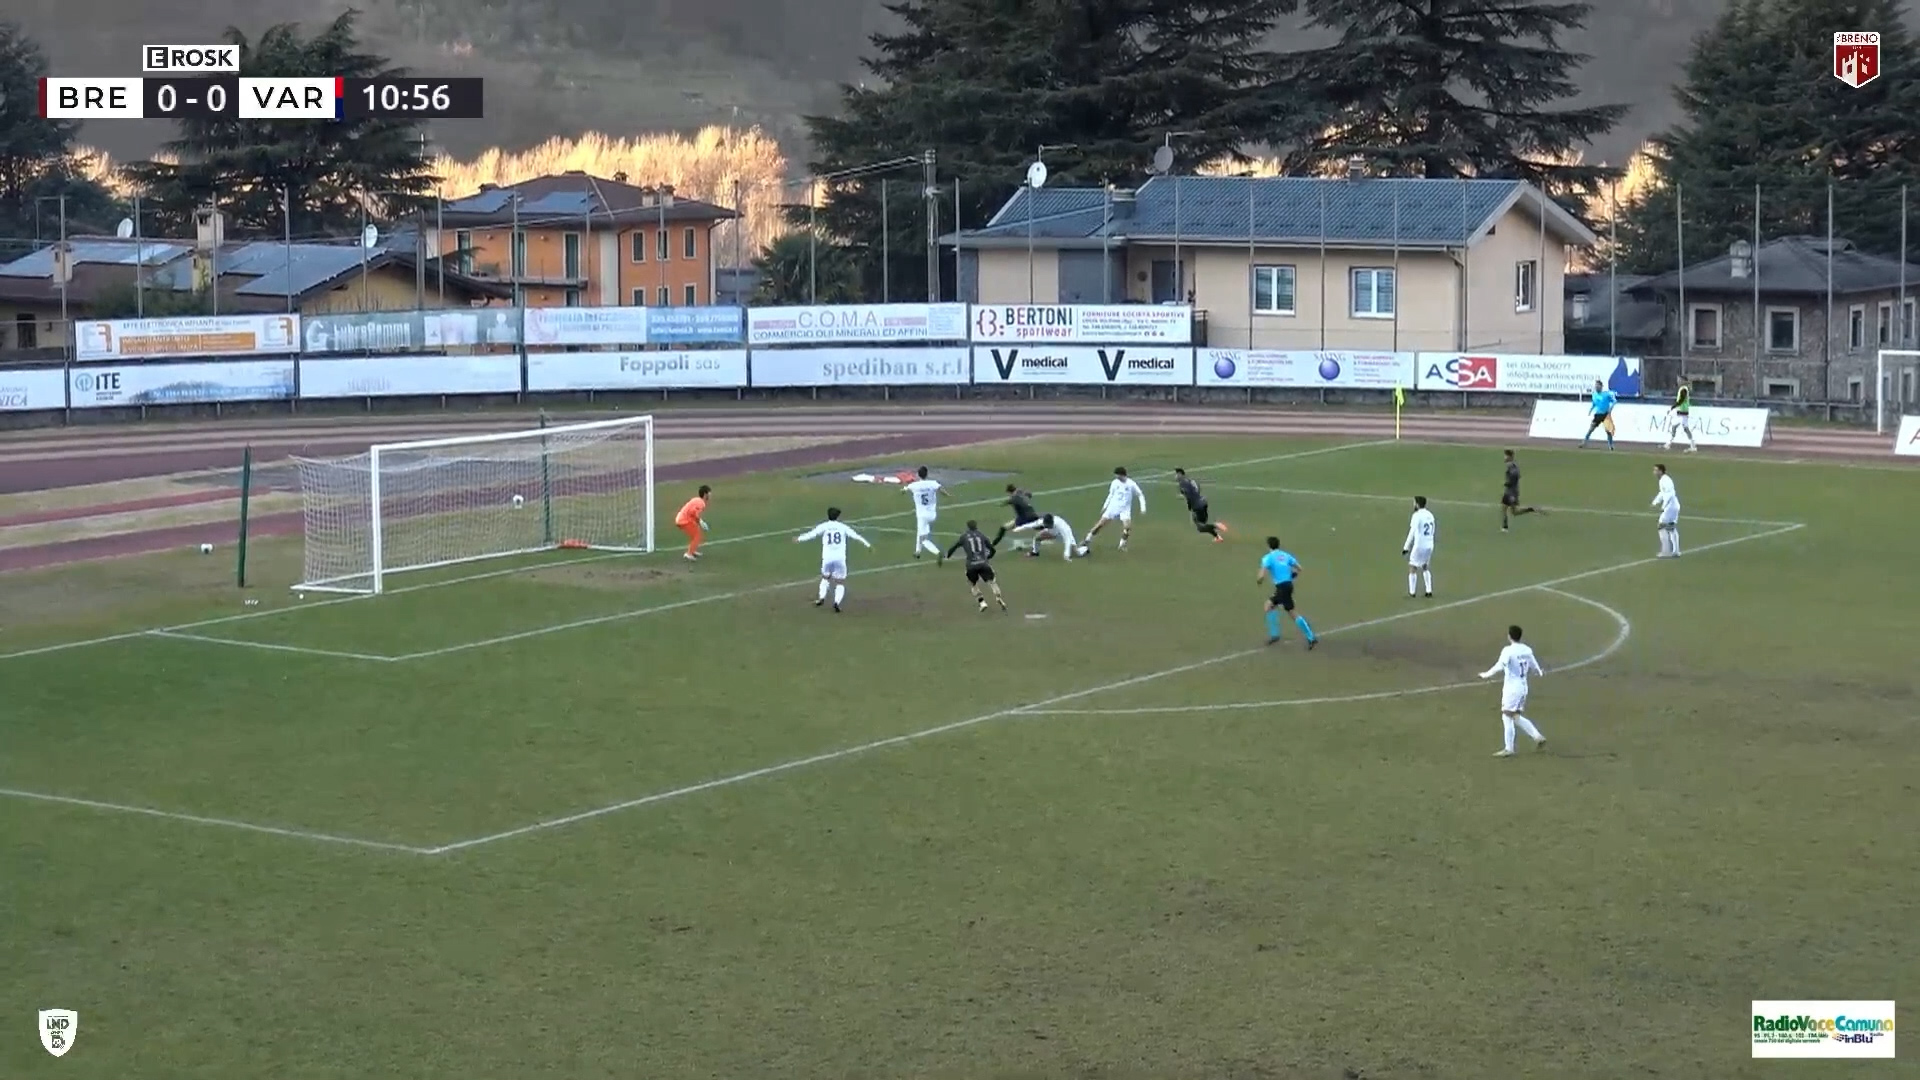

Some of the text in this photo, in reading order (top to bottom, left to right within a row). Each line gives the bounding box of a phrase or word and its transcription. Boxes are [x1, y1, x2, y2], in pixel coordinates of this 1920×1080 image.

[1006, 308, 1073, 326] BERTONI
[753, 329, 814, 340] COMMERCIO
[835, 328, 880, 338] MINERALI
[897, 328, 928, 337] AFFINI
[1016, 327, 1073, 338] sportwear
[620, 355, 720, 375] Foppoli sas
[823, 357, 918, 380] spediban
[991, 349, 1068, 380] V medical
[1097, 349, 1175, 381] V medical
[1425, 357, 1493, 387] ASA
[95, 372, 121, 391] ITE
[1649, 414, 1731, 435] MALS
[827, 531, 841, 545] 18
